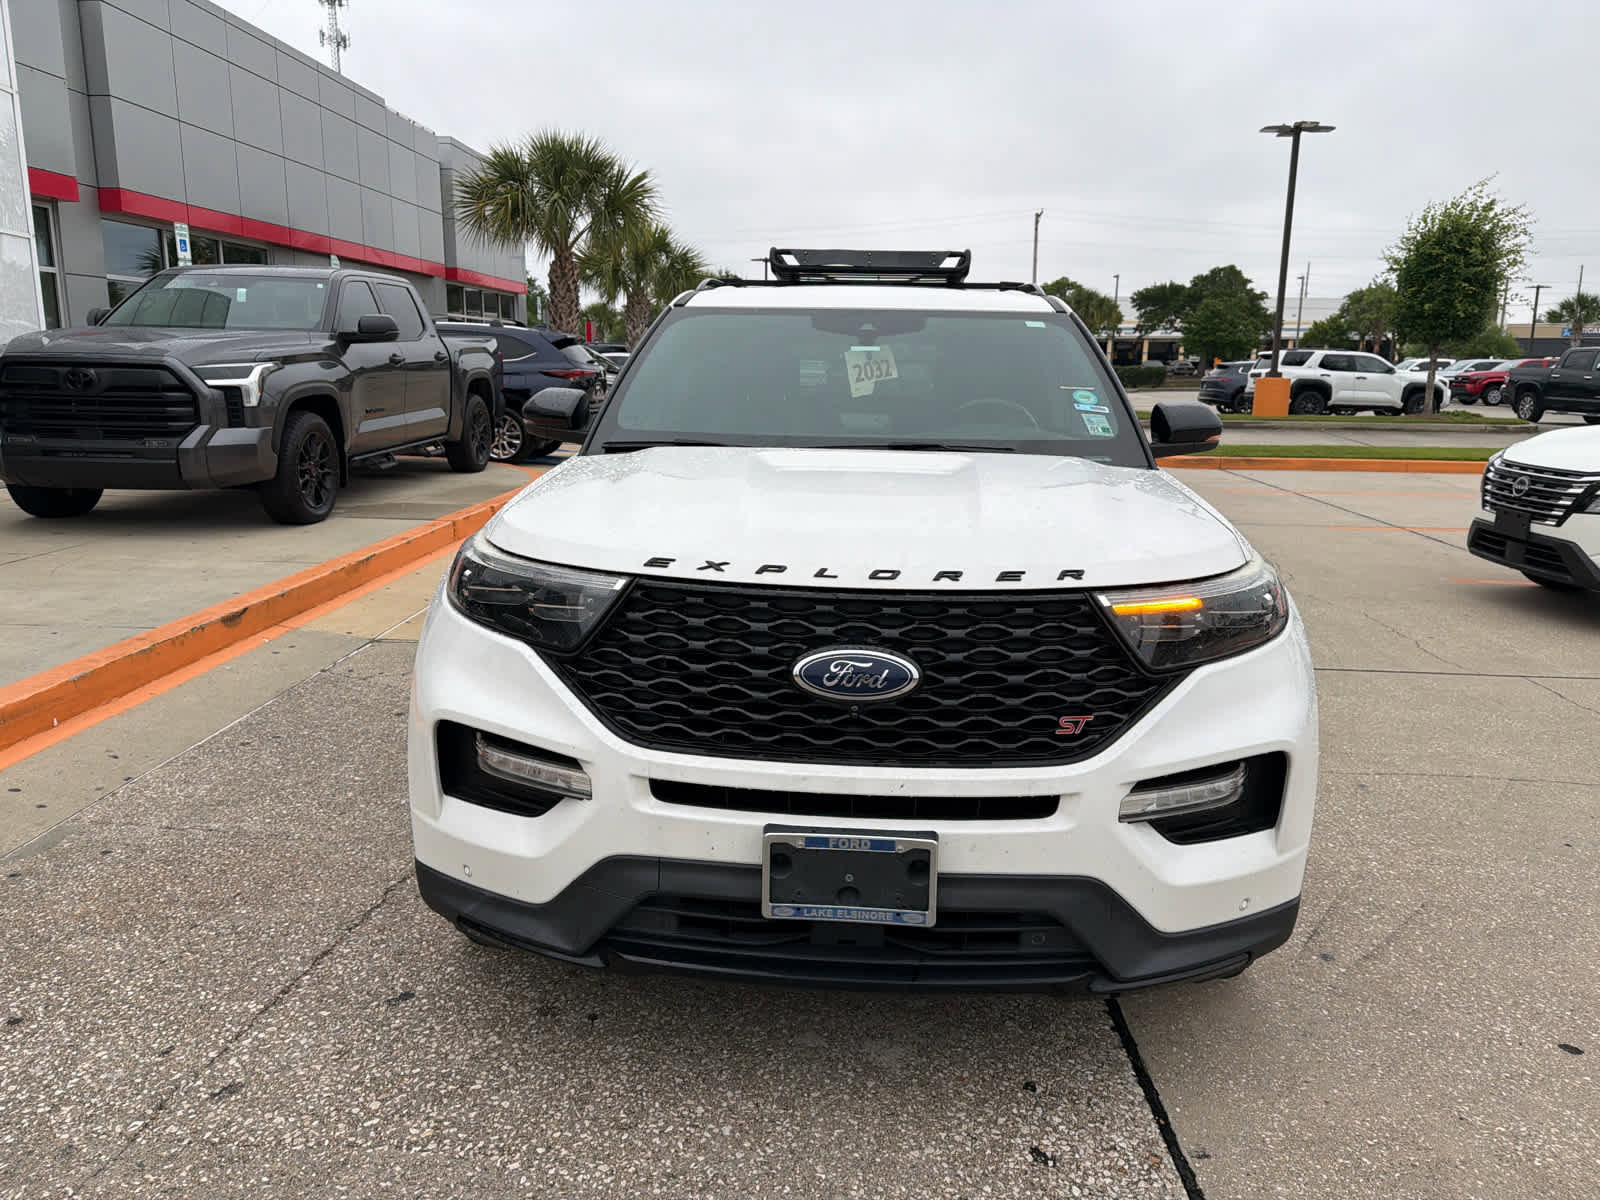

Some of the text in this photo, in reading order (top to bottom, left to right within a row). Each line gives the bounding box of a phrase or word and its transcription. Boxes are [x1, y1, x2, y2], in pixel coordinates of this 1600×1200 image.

[643, 557, 1085, 582] EXPLORER
[823, 660, 889, 688] Ford
[1056, 716, 1094, 734] ST
[828, 838, 871, 850] FORD
[803, 906, 833, 918] LAKE
[836, 908, 894, 921] ELSINORE
